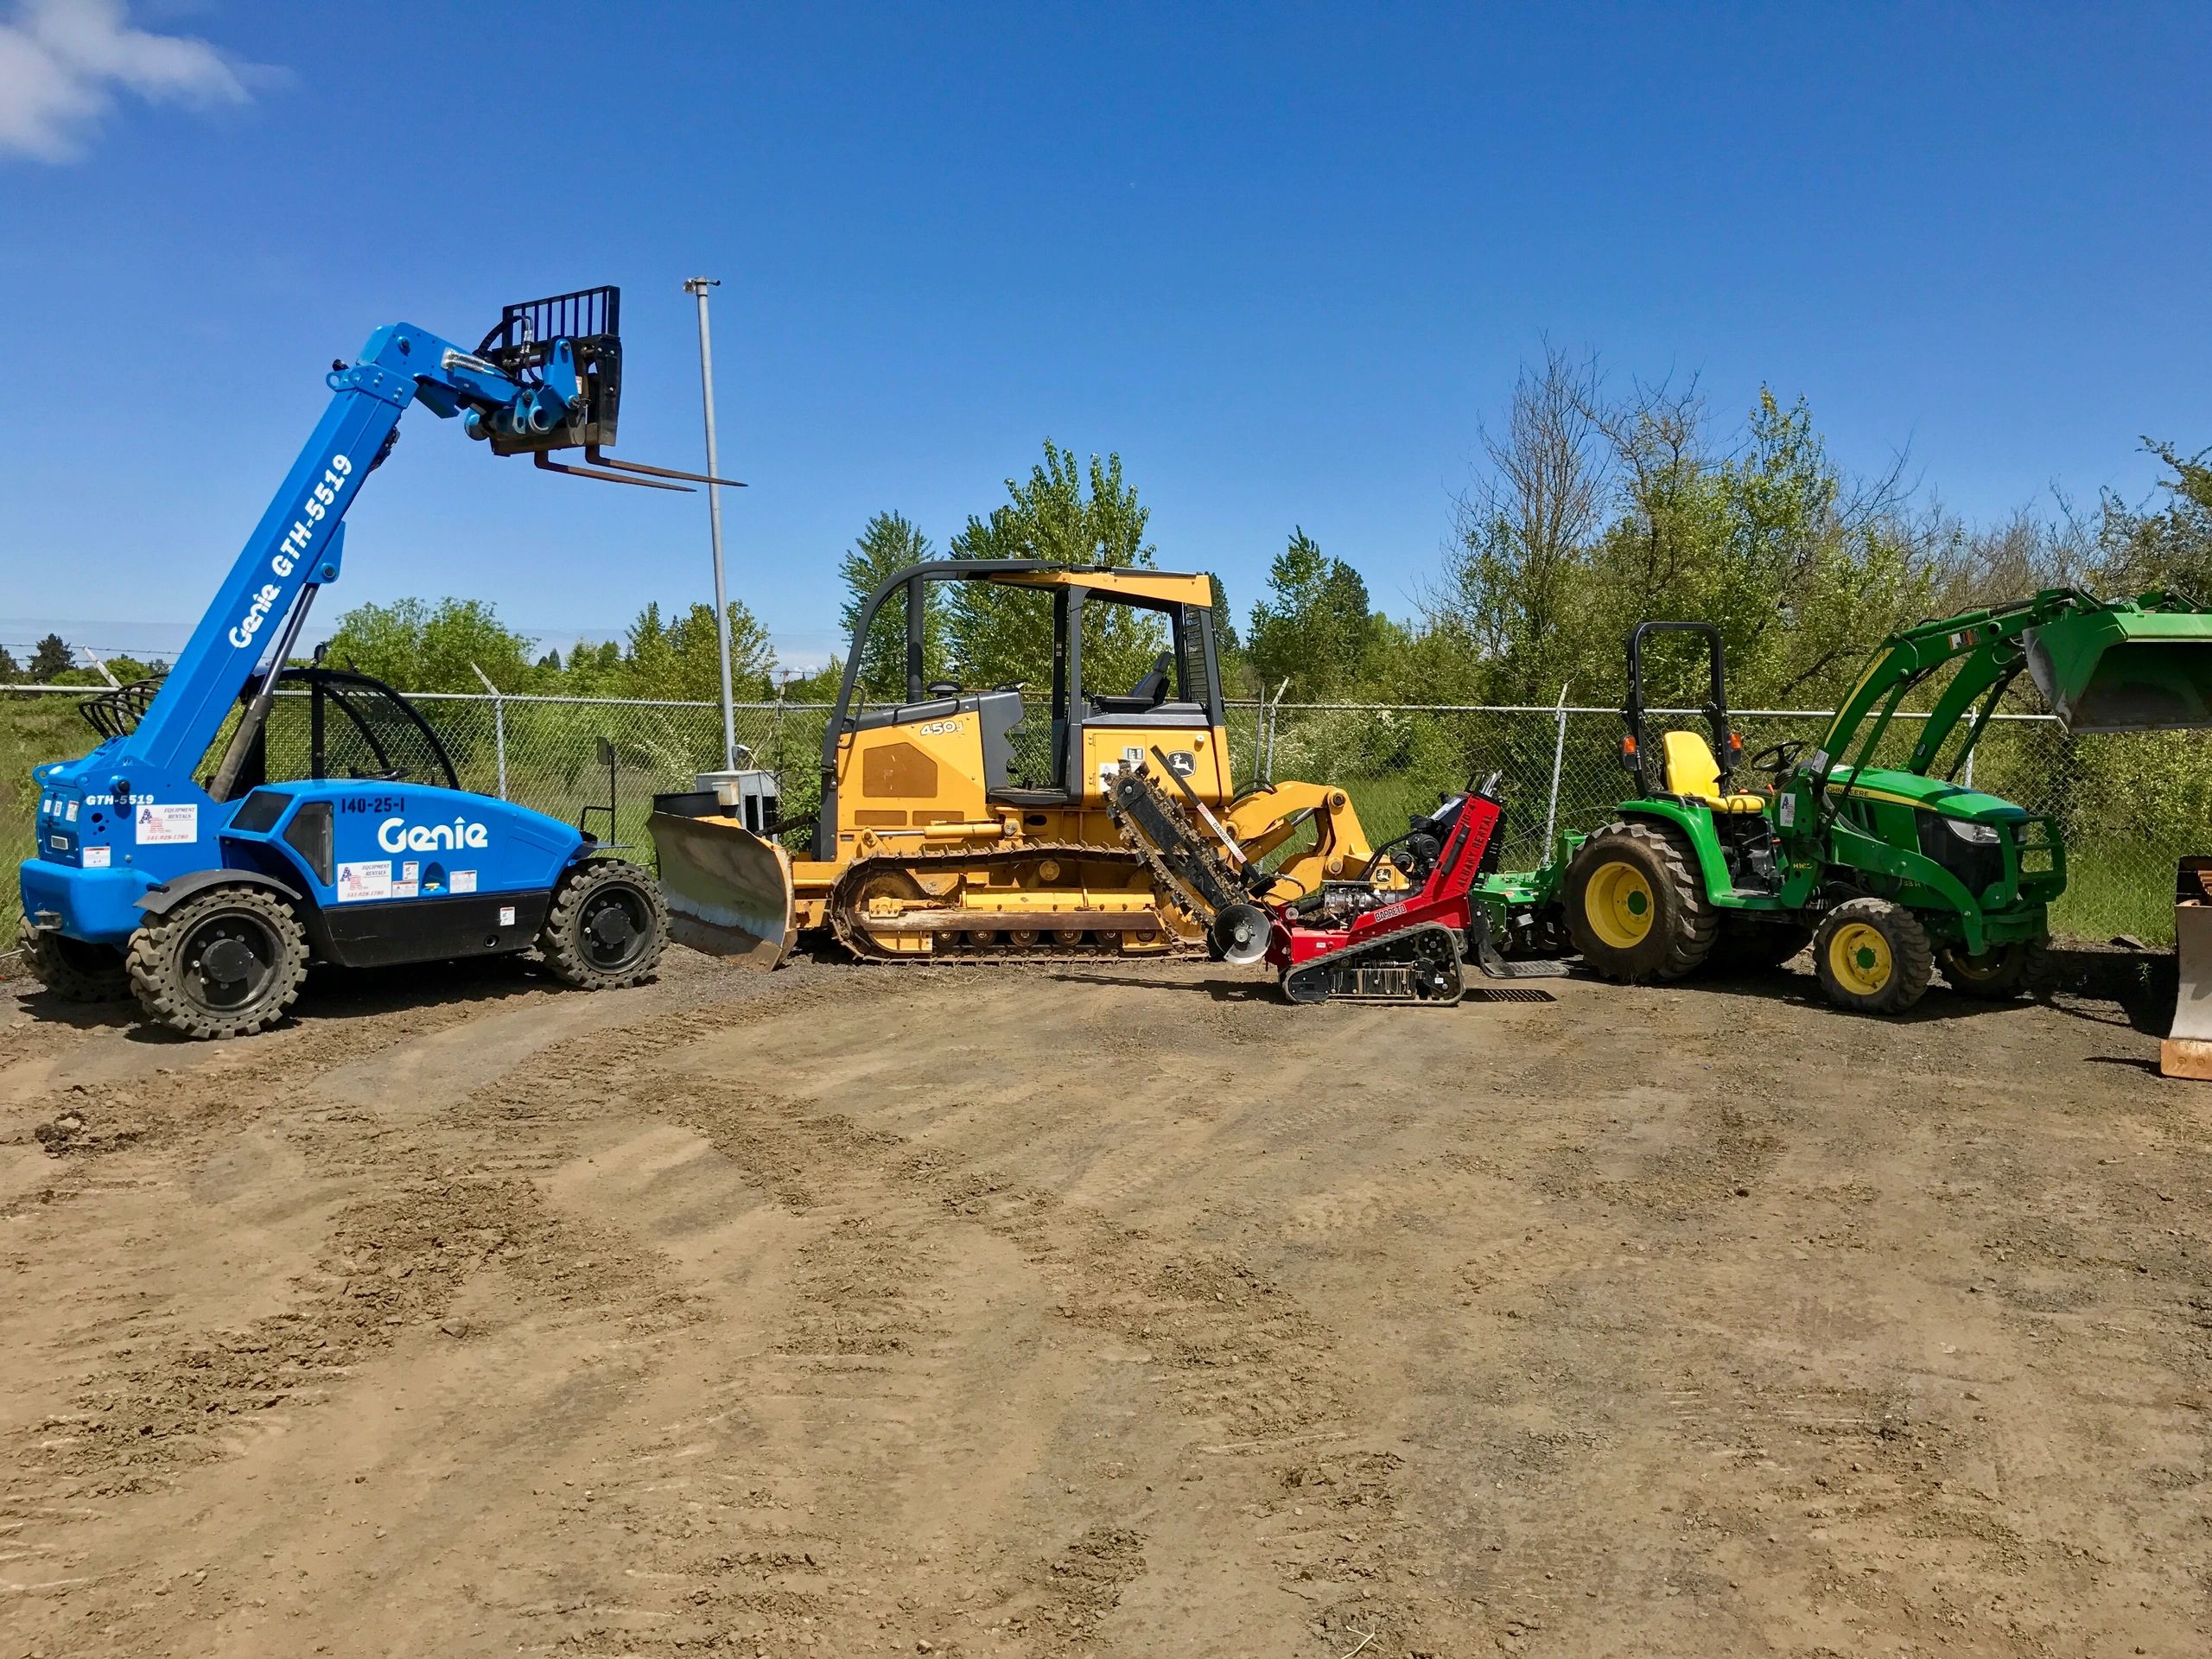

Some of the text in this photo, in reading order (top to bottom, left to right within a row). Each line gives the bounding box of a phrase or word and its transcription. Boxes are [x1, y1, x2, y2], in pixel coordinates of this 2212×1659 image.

[229, 454, 353, 648] Genie GTH-5519
[86, 794, 155, 805] GTH-5519
[341, 798, 404, 813] 140-25-1
[378, 816, 488, 854] Genie
[1212, 822, 1231, 844] DANGER
[1457, 814, 1494, 888] ALBANY RENTAL
[1375, 904, 1407, 922] BARRETO
